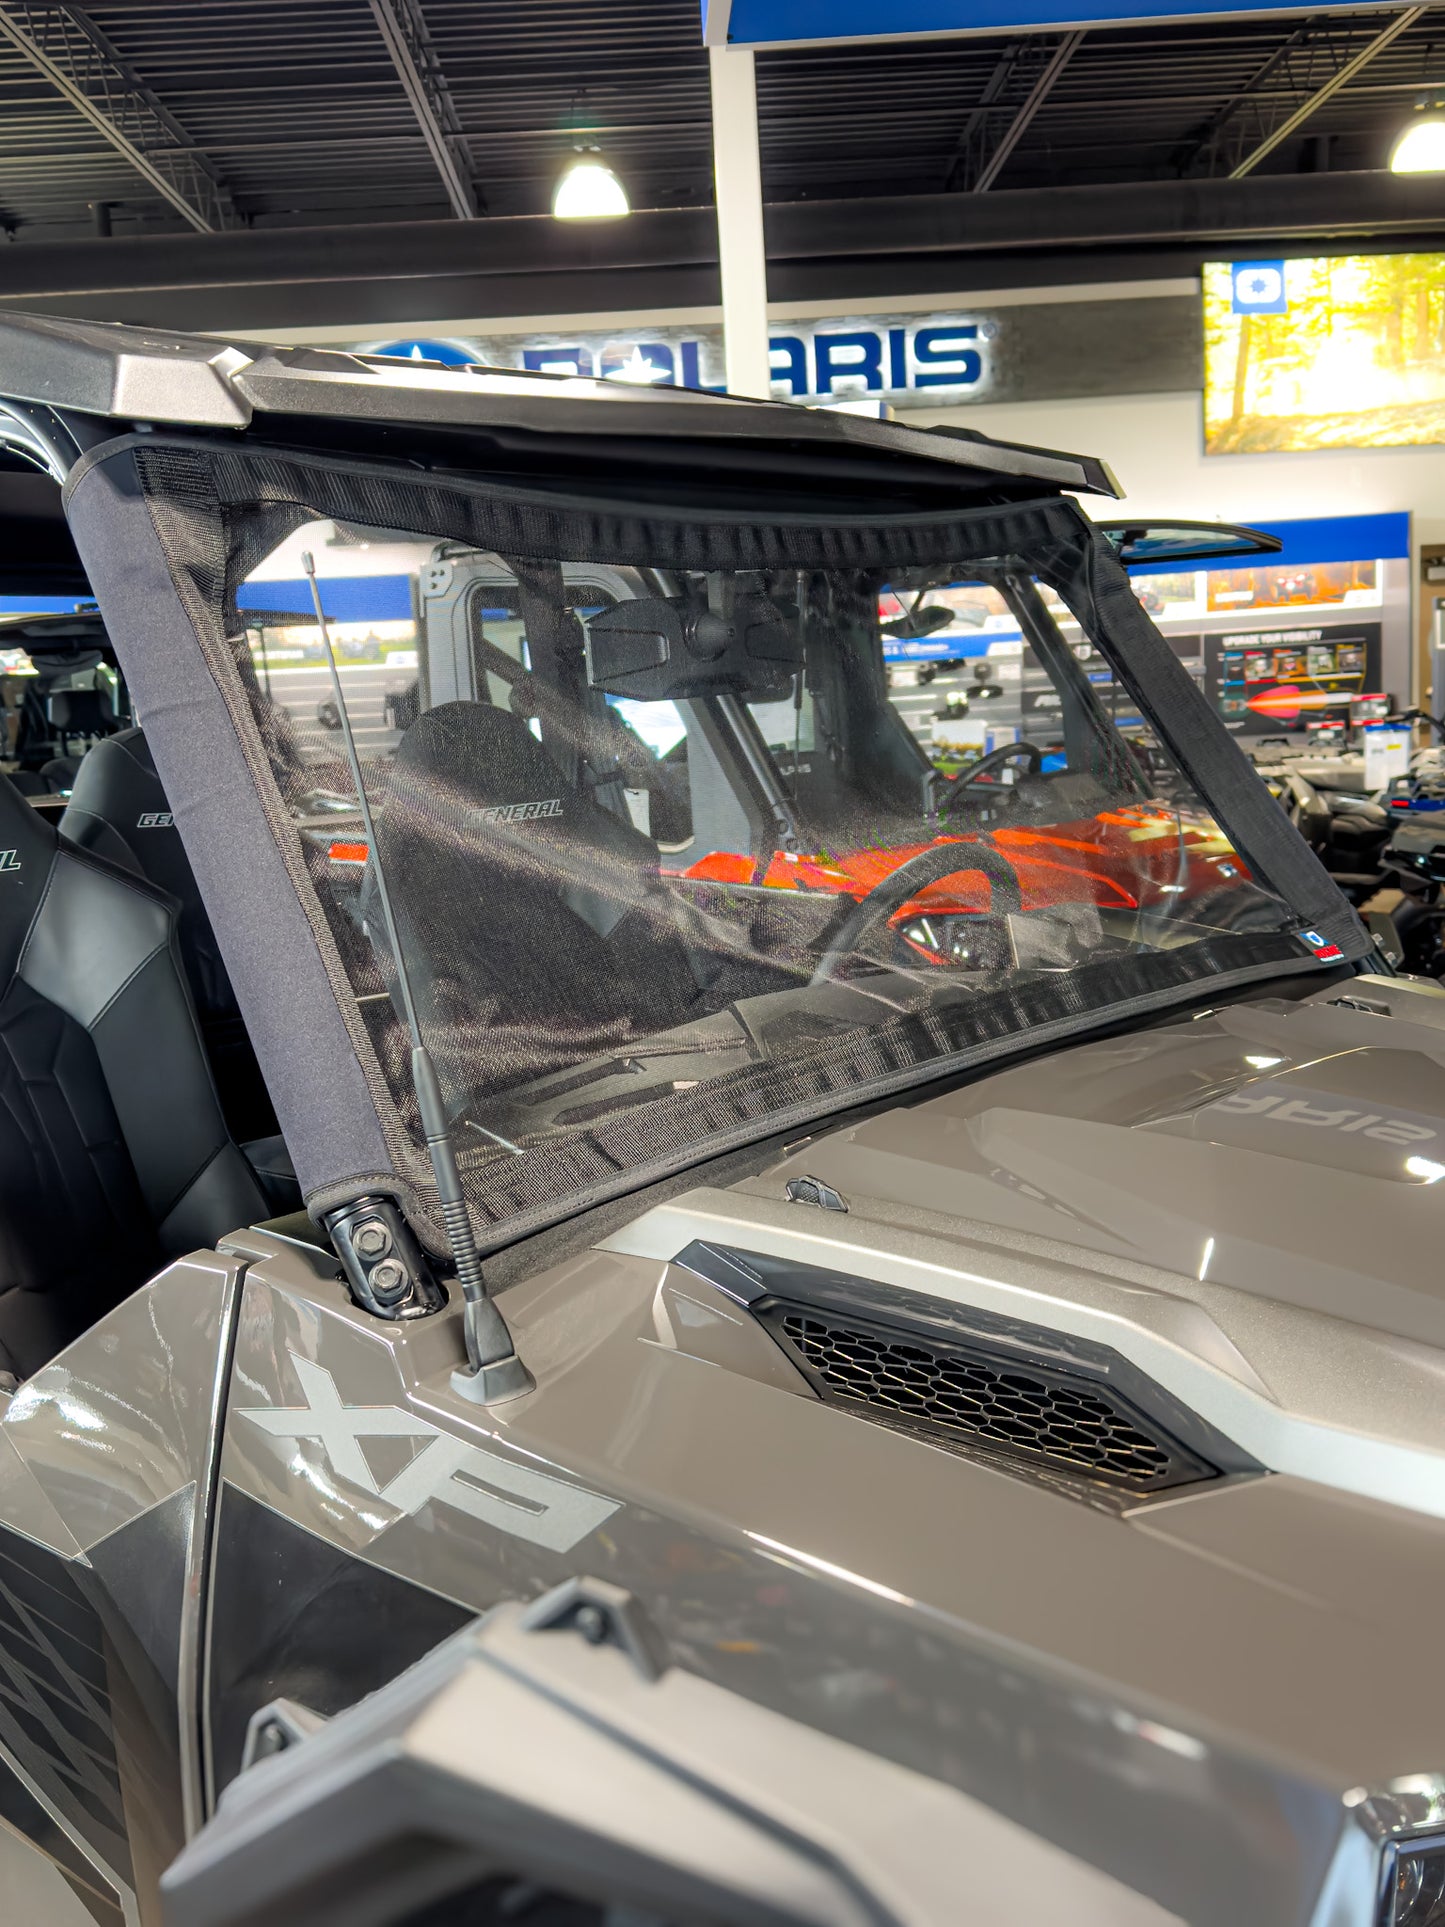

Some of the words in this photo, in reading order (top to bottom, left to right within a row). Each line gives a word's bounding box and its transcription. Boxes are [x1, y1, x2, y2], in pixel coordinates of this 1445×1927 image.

[1261, 632, 1282, 645] YOUR
[0, 849, 22, 872] L
[232, 1349, 626, 1554] XP
